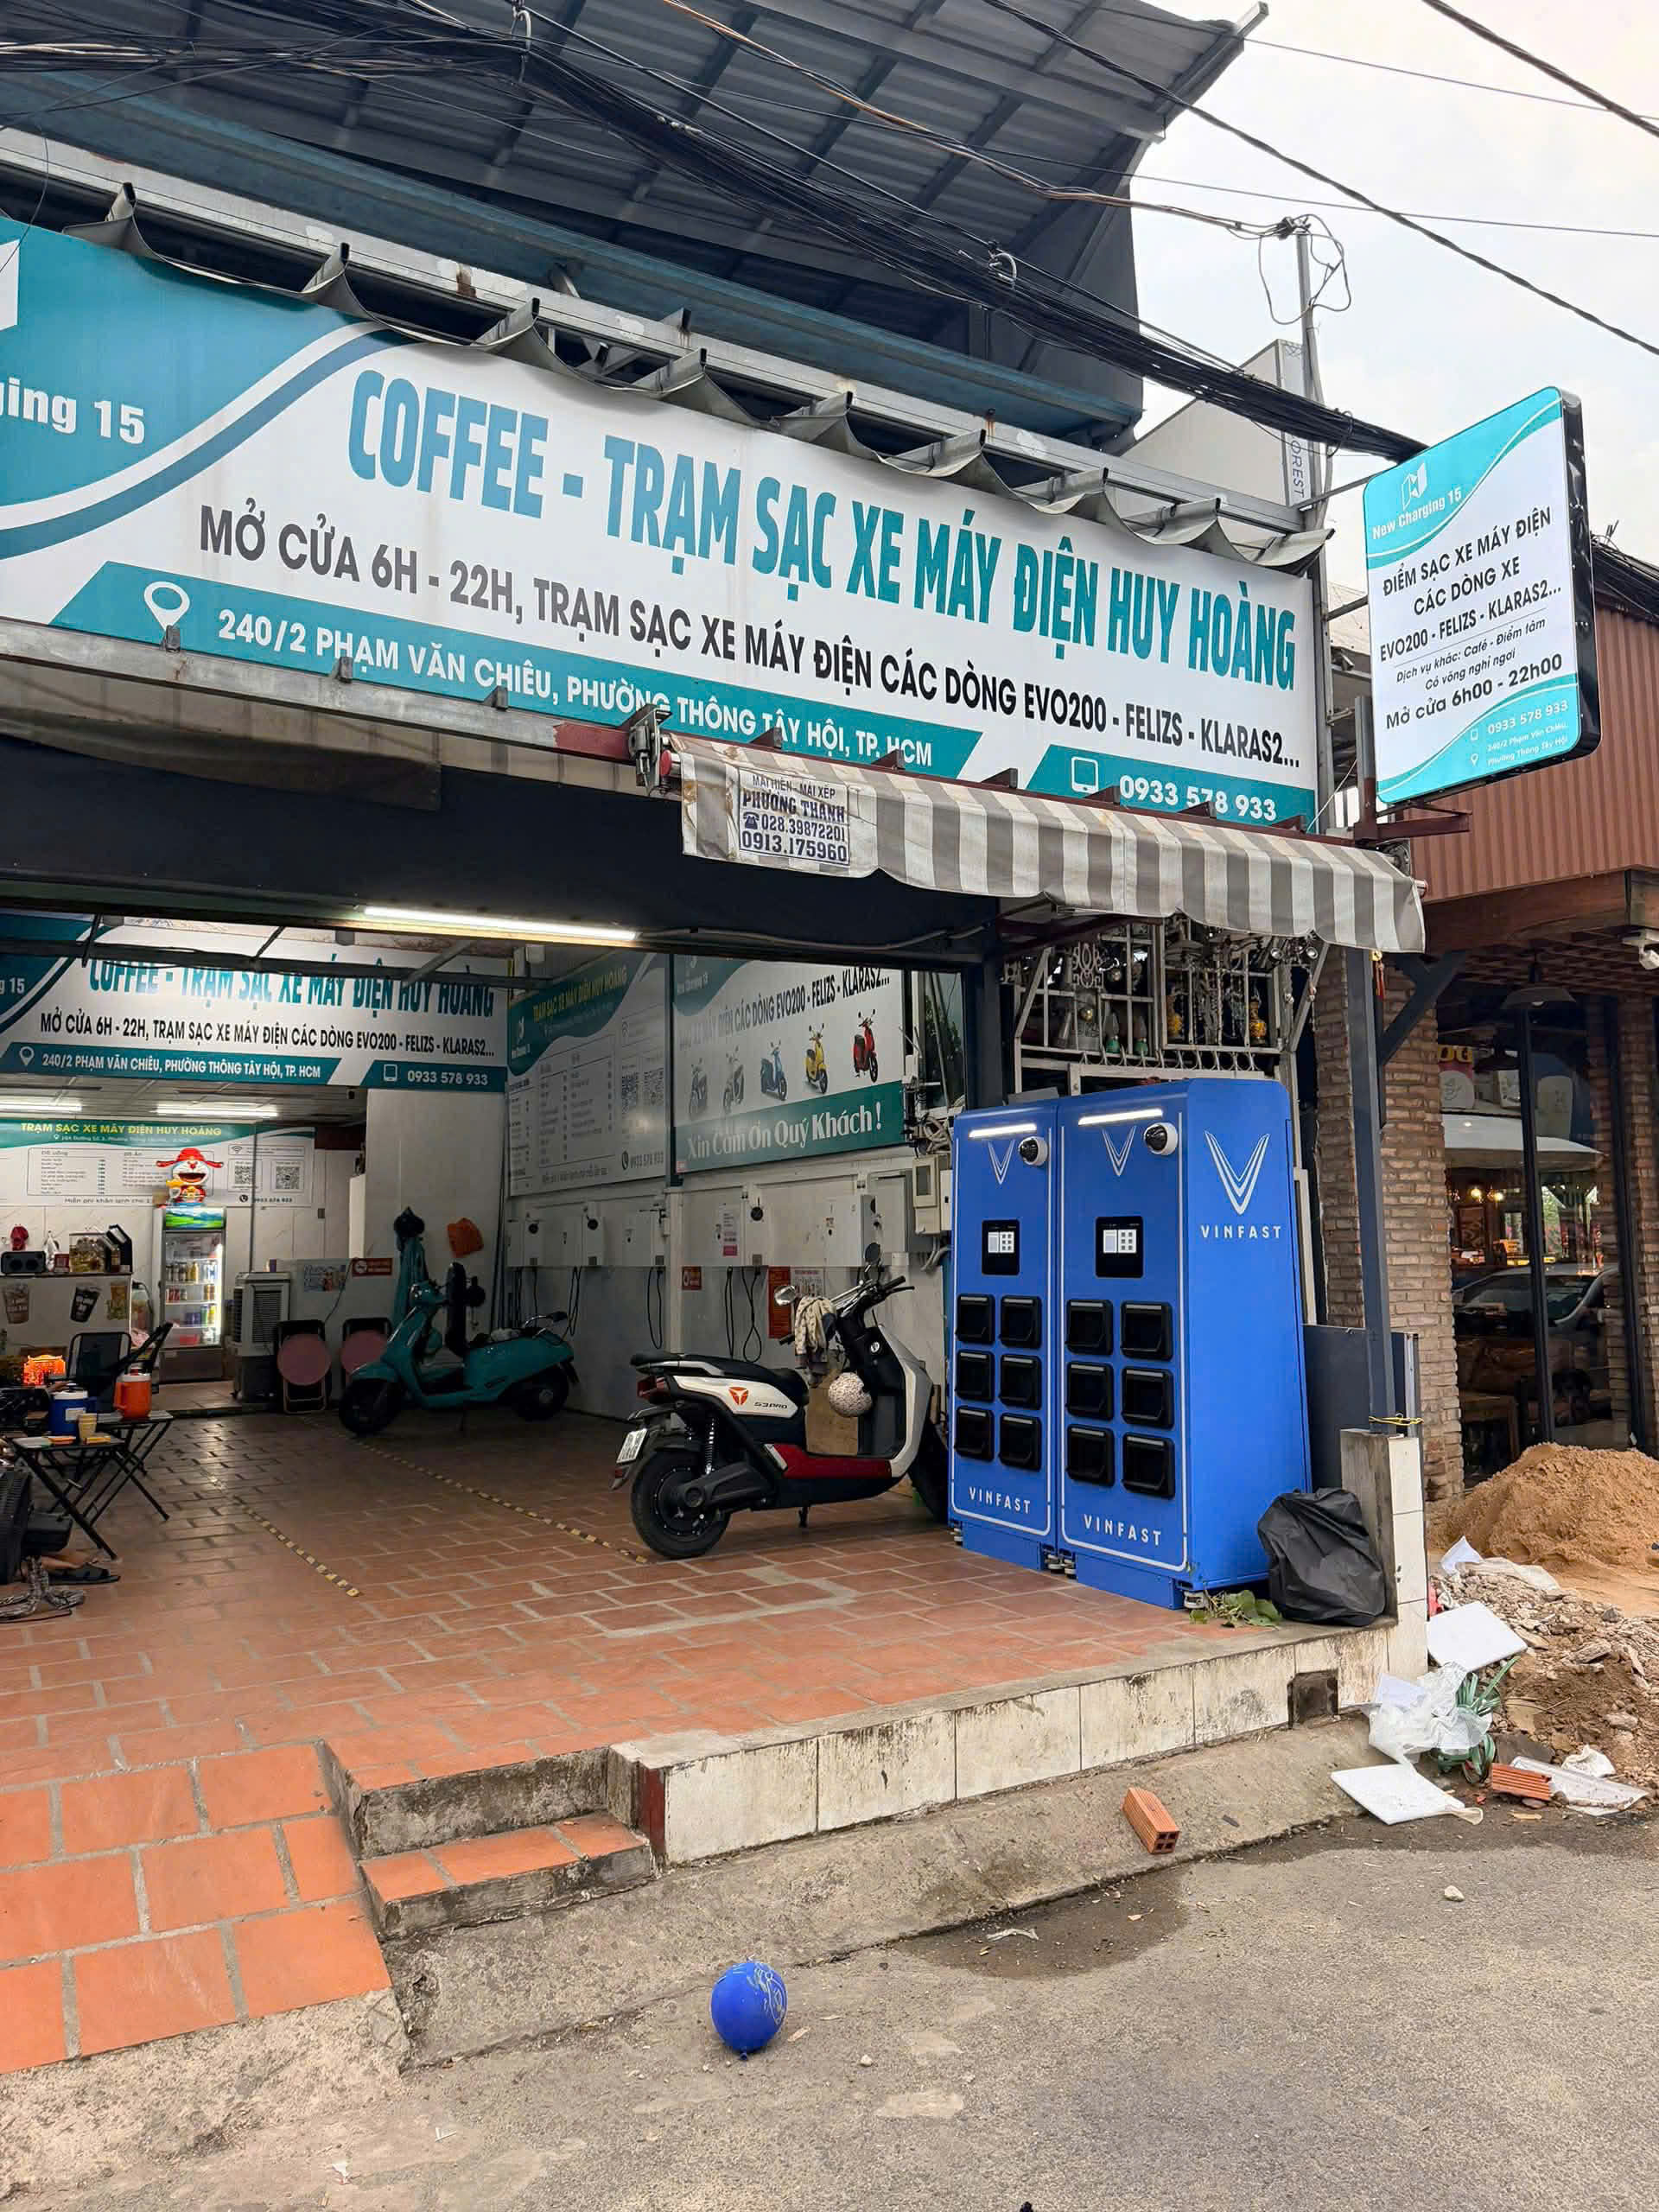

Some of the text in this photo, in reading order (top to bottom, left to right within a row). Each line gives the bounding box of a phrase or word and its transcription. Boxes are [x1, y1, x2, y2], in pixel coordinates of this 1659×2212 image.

[0, 377, 145, 445] ing 15
[1290, 435, 1306, 499] OREST
[349, 369, 1295, 691] COFFEE TRẠM SẠC XE MÁY ĐIỆN HUY HOÀNG
[1371, 486, 1462, 540] New Charging 15
[1382, 506, 1551, 596] ĐIỂM SẠC XE MÁY ĐIỆN
[1414, 556, 1521, 615] CÁC DÒNG XE
[200, 498, 1300, 768] MỞ CỬA 6H 22H, TRẠM SẠC XE MÁY ĐIỆN CÁC DÒNG EVO200 FELIZS KLARAS2...
[1380, 580, 1561, 662] EVO200 FELIZS KLARAS2...
[1396, 617, 1546, 685] Dịch vụ khác: Café Điểm tâm
[1425, 648, 1516, 690] Có võng nghỉ ngơi
[219, 608, 932, 767] 240/2 PHẠM VĂN CHIÊU, PHƯỜNG THÔNG TÂY HỘI, TP. HCM
[1386, 653, 1562, 729] Mở cửa 6h00 22h00
[1488, 700, 1568, 734] 0933 578 933
[1119, 775, 1277, 822] 0933 578 933
[742, 830, 847, 862] 0913.175960
[761, 814, 845, 842] 028.39872201
[10, 977, 25, 994] 15
[89, 959, 159, 993] COFFEE
[181, 966, 233, 1008] TRẠM
[278, 973, 302, 1004] XE
[308, 953, 346, 1009] MÁY
[353, 957, 392, 1018] ĐIỆN
[398, 978, 432, 1014] HUY
[438, 965, 494, 1017] HOÀNG
[734, 1000, 752, 1033] CÁC
[753, 993, 775, 1027] DÒNG
[777, 985, 805, 1020] EVO200
[811, 975, 836, 1008] FELIZS
[41, 1007, 61, 1033] MỞ
[66, 1007, 92, 1035] CỬA
[96, 1016, 112, 1036] 6H
[123, 1018, 149, 1041] 22H,
[153, 1020, 185, 1044] TRẠM
[188, 1022, 213, 1046] SẠC
[216, 1023, 231, 1042] XE
[233, 1020, 259, 1044] MÁY
[263, 1021, 288, 1050] ĐIỆN
[292, 1023, 317, 1046] CÁC
[321, 1025, 353, 1048] DÒNG
[357, 1032, 397, 1051] EVO200
[405, 1034, 435, 1053] FELIZS
[442, 1037, 495, 1058] KLARAS2...
[42, 1053, 73, 1068] 240/2
[74, 1055, 104, 1072] PHẠM
[106, 1053, 128, 1071] VĂN
[130, 1055, 162, 1074] CHIÊU,
[165, 1055, 207, 1073] PHƯỜNG
[208, 1058, 242, 1074] THÔNG
[244, 1059, 261, 1076] TÂY
[264, 1061, 283, 1078] HỘI,
[299, 1065, 321, 1078] HCM
[407, 1071, 437, 1084] 0933
[442, 1071, 462, 1084] 578
[466, 1073, 488, 1086] 933
[686, 1135, 710, 1160] Xin
[774, 1117, 809, 1147] Quý
[1201, 1225, 1282, 1240] VINFAST
[969, 1487, 1031, 1515] VINFAST
[1084, 1514, 1162, 1547] VINFAST
